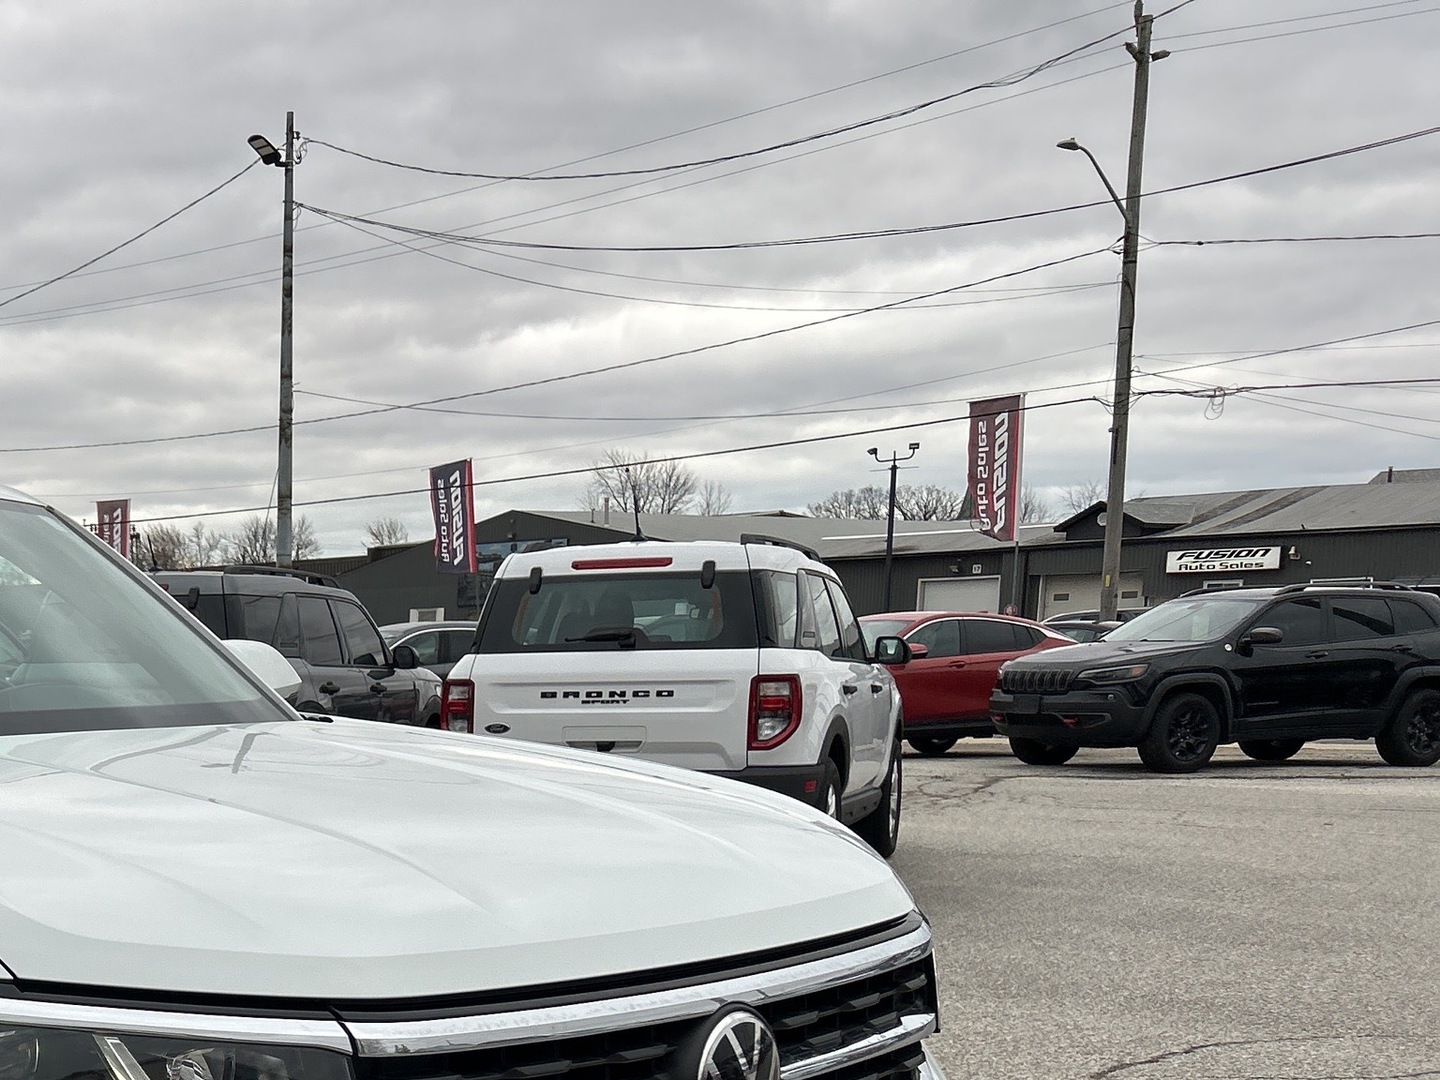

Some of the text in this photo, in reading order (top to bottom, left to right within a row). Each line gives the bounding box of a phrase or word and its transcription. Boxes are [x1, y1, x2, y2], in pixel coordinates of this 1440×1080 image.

[1176, 548, 1272, 560] FUSION
[1178, 561, 1264, 571] Auto Sales
[540, 690, 674, 699] BRONCO
